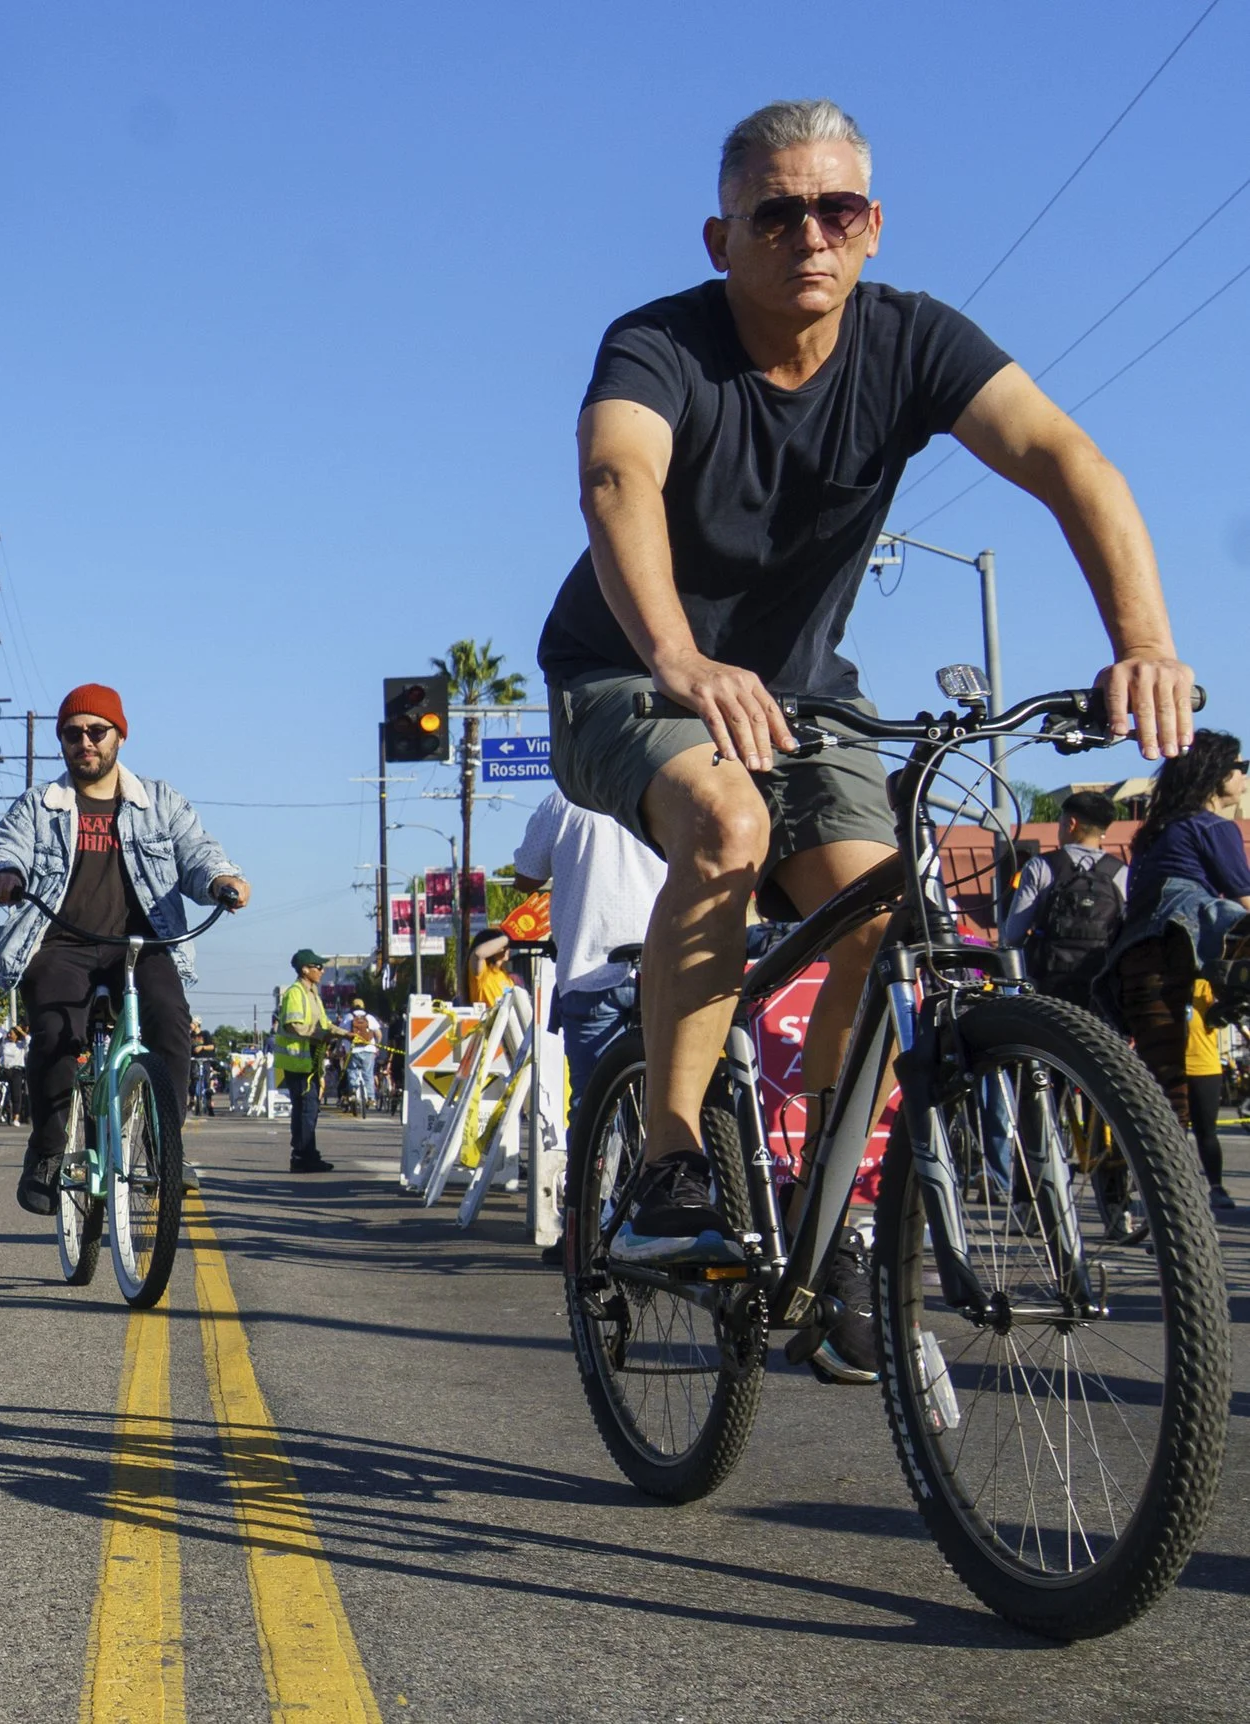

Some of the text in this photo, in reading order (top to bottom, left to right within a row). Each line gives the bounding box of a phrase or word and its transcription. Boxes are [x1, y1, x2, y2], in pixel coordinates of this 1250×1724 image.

[526, 739, 550, 753] Vin
[490, 763, 551, 777] Rossmo
[879, 1263, 934, 1499] SPECIALIZED
